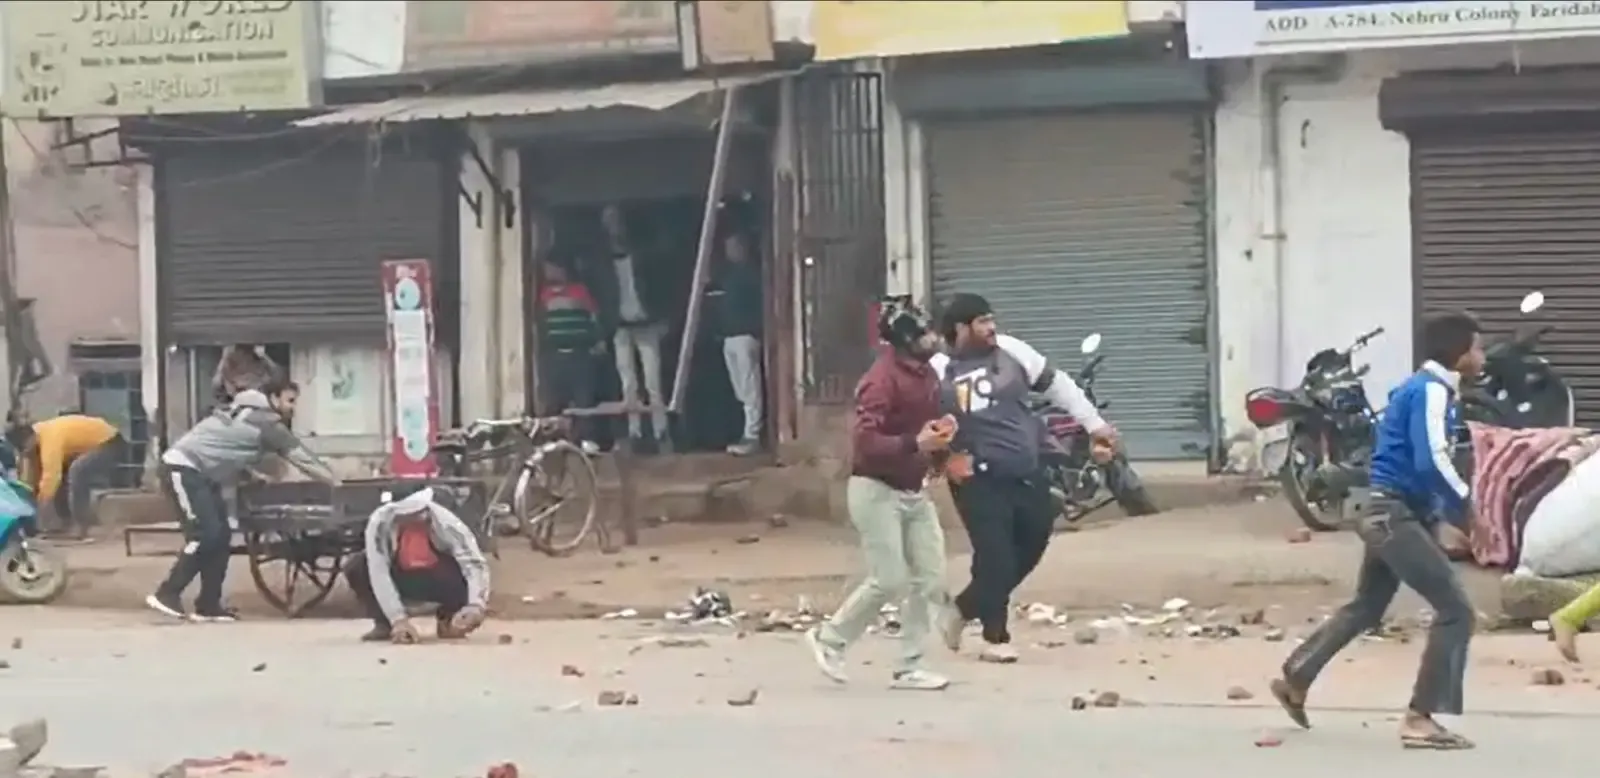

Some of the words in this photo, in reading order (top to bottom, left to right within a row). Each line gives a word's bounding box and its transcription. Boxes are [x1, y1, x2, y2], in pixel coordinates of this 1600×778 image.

[1266, 15, 1308, 31] ADD
[1390, 8, 1449, 25] Nehru
[1455, 5, 1520, 23] Colony
